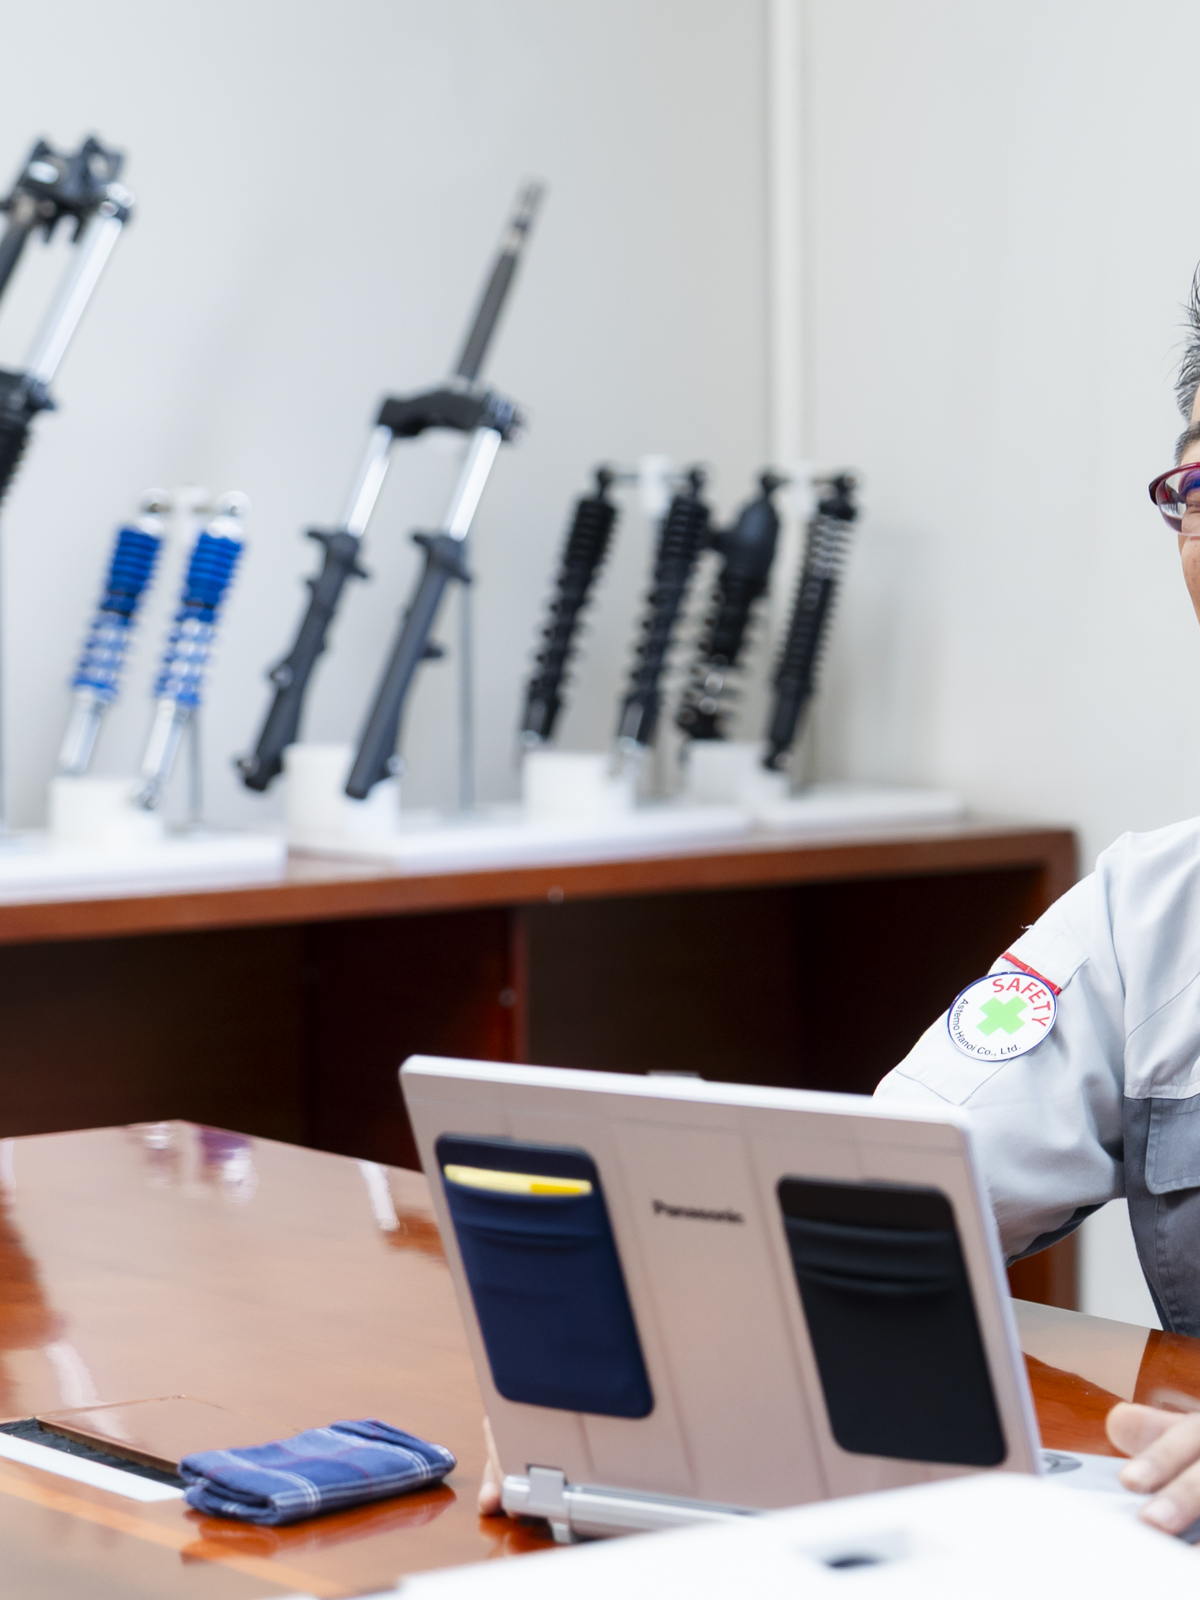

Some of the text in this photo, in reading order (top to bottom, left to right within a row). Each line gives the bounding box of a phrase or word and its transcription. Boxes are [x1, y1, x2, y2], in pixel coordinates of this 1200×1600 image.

[953, 998, 969, 1031] Astemo
[992, 977, 1051, 1027] SAFETY
[955, 1031, 977, 1051] Hanoi
[1000, 1044, 1021, 1055] Ltd.
